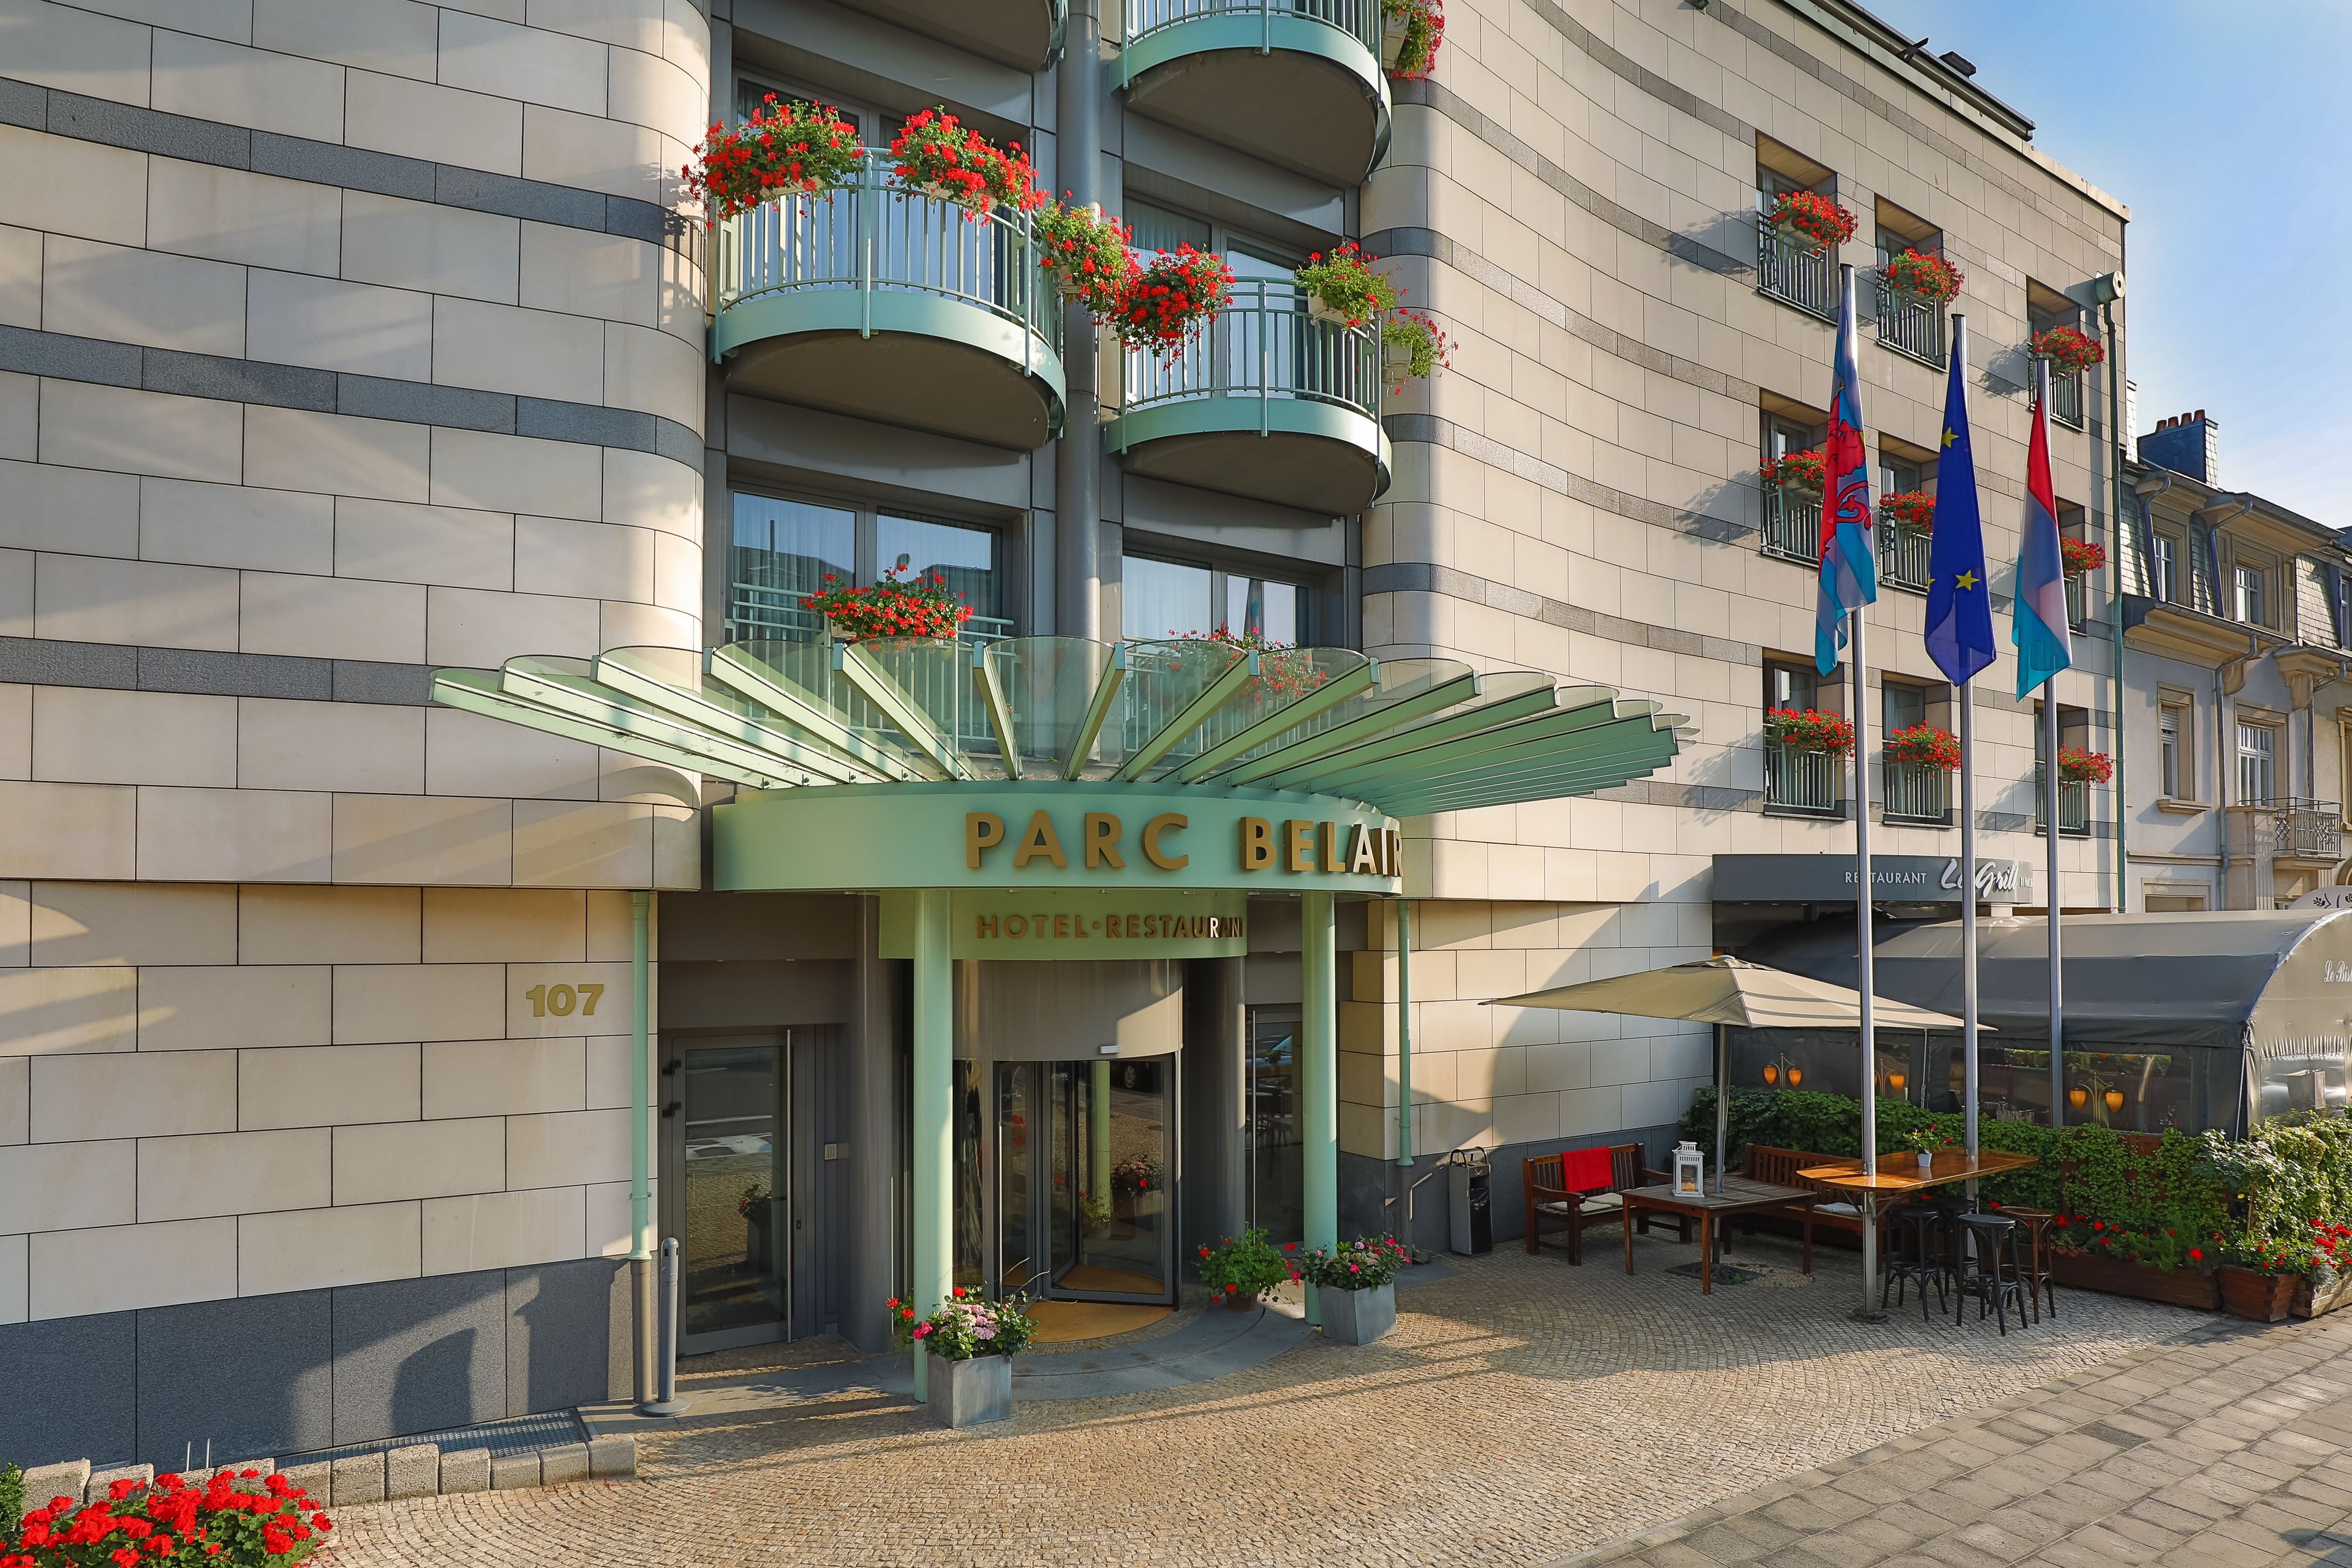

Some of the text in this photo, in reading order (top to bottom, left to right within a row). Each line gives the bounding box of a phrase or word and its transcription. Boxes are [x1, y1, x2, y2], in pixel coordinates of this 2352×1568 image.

[965, 809, 1404, 877] PARC BELAIR
[1845, 872, 1927, 884] RETAURANT
[1975, 861, 2019, 899] Grill
[2323, 960, 2335, 982] Le
[526, 984, 605, 1017] 107
